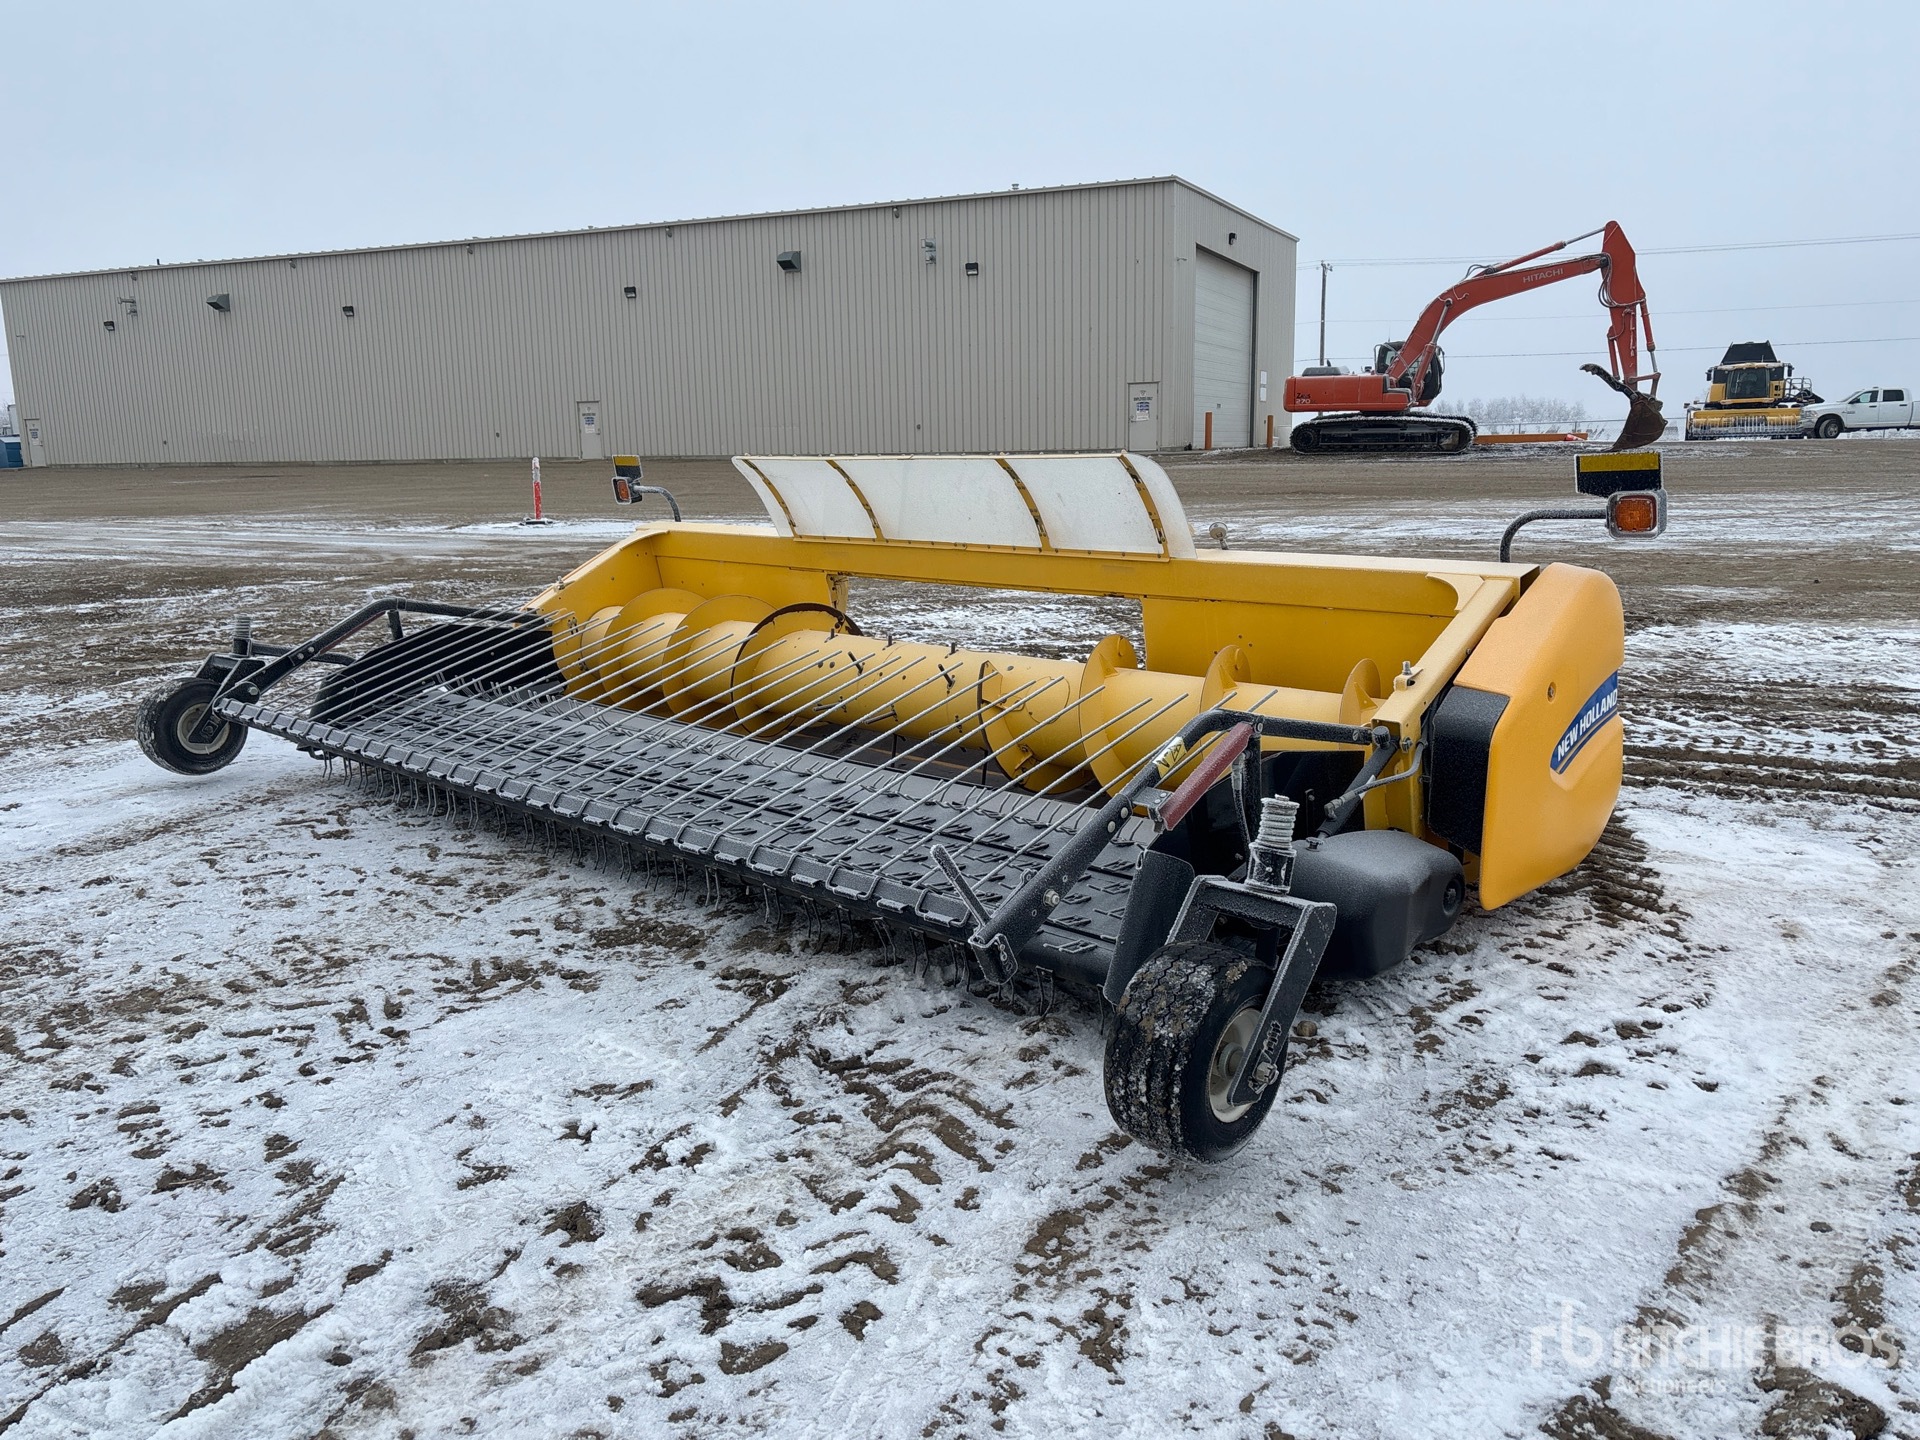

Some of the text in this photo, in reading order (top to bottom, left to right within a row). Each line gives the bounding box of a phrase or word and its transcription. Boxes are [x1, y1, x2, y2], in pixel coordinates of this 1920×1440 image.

[1522, 267, 1564, 283] HITACHI
[1557, 688, 1618, 762] NEW HOLLAND
